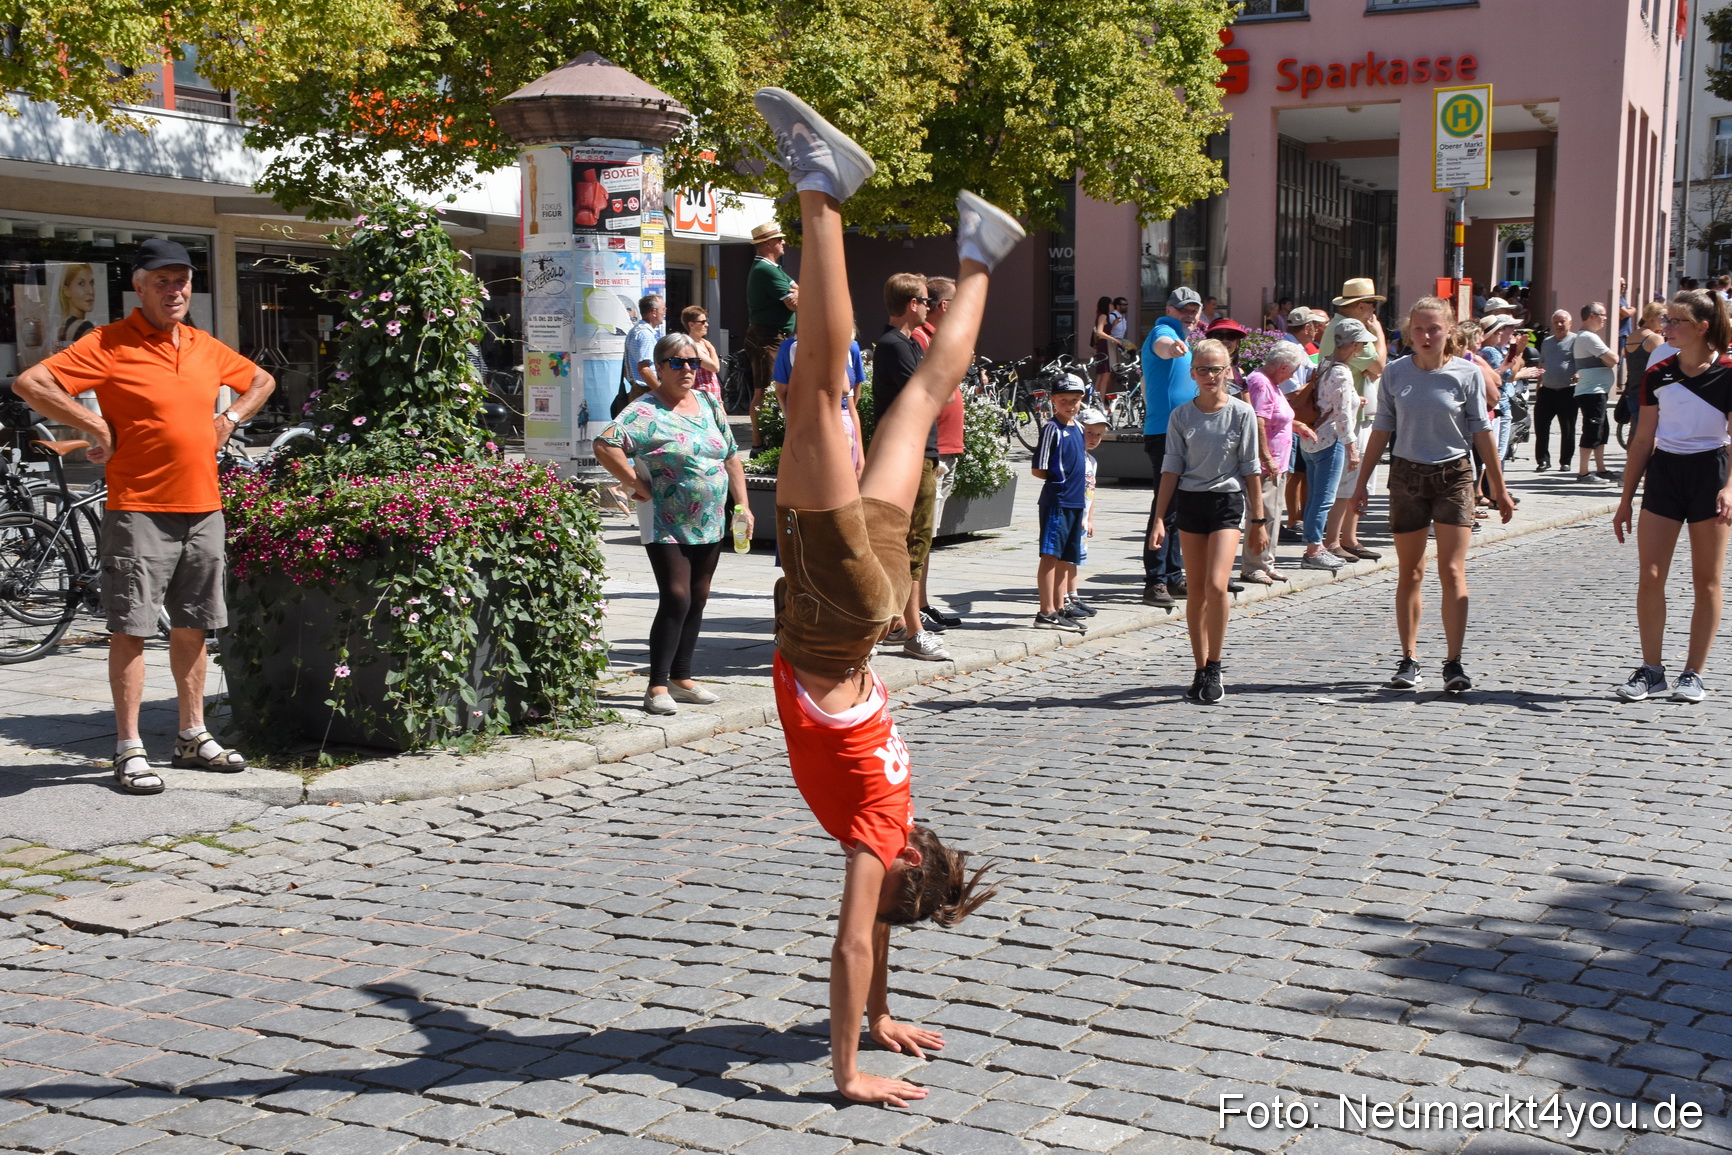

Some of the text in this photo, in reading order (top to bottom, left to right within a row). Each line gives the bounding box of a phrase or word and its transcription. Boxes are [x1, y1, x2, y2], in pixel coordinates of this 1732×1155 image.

[1276, 51, 1478, 99] Sparkasse
[1452, 104, 1472, 128] H
[602, 168, 640, 180] BOXEN
[542, 203, 562, 211] FOKUS
[578, 458, 602, 467] EUMA
